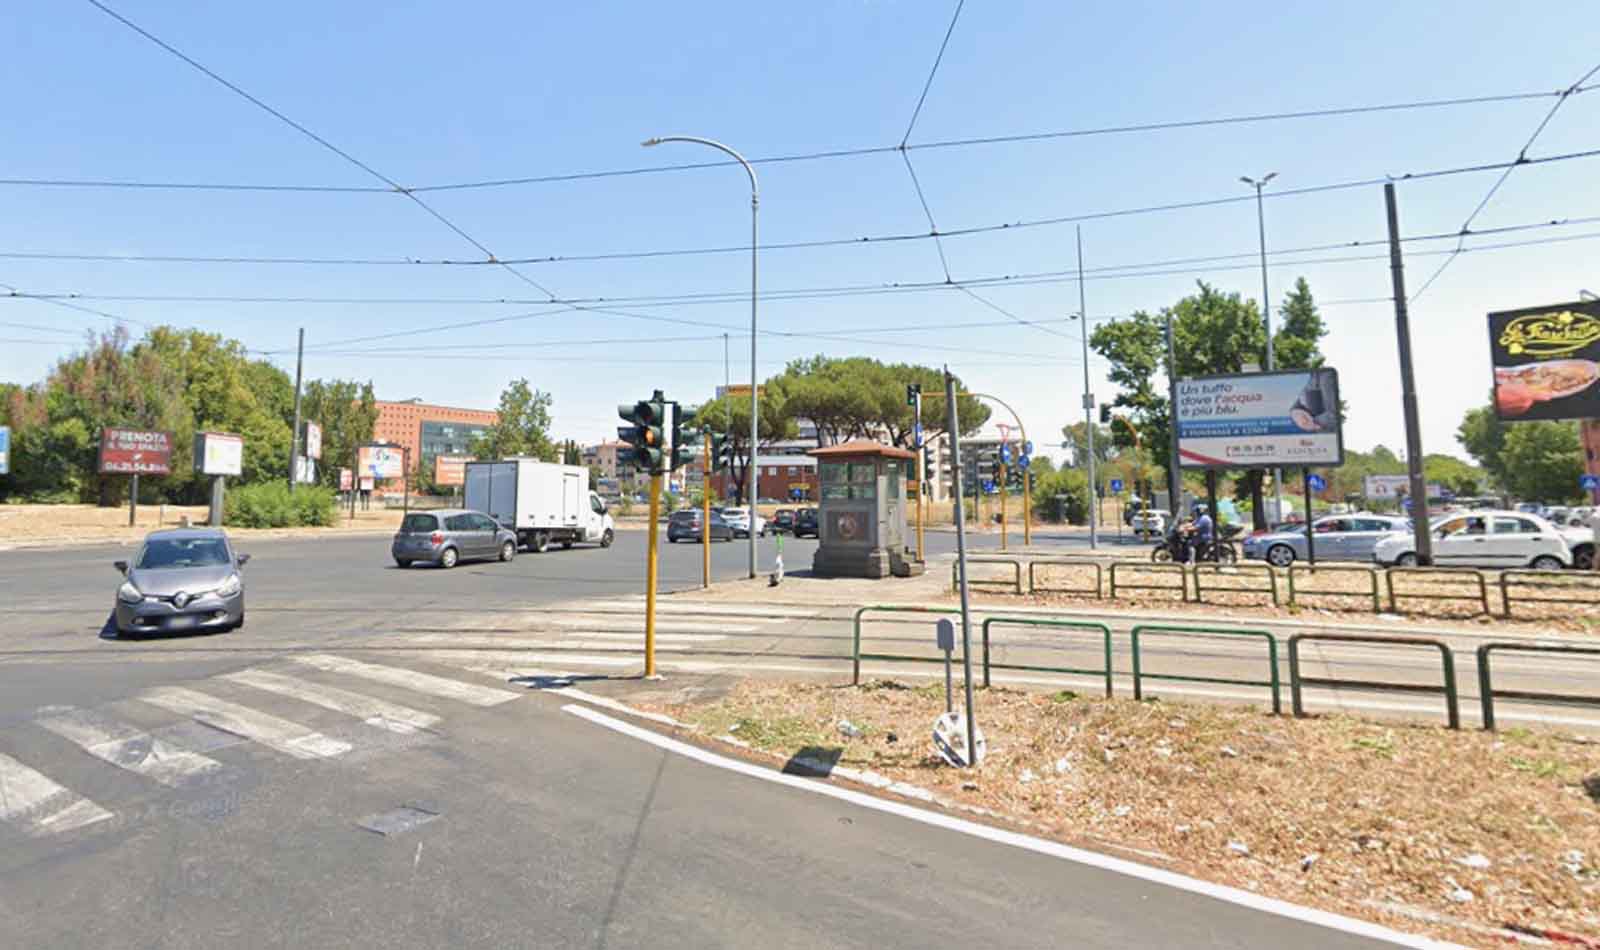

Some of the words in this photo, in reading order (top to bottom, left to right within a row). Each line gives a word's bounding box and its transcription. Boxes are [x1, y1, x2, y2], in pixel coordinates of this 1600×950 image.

[1181, 385, 1199, 394] Un
[1202, 383, 1233, 393] tuffo
[1181, 396, 1212, 405] dove
[111, 430, 167, 442] PRENOTA
